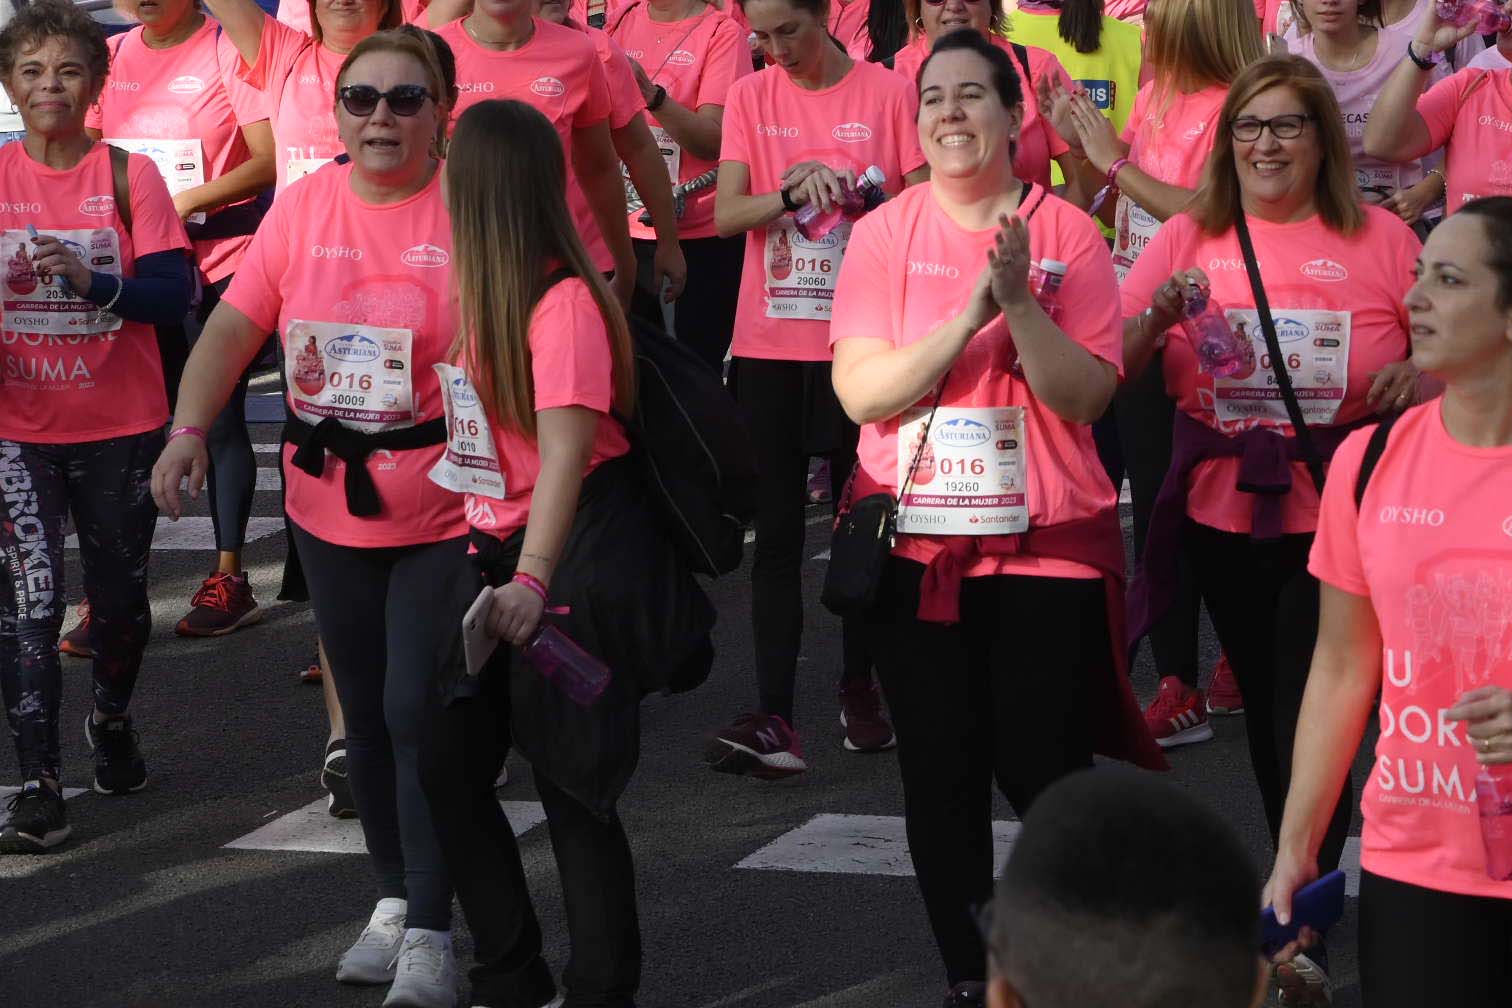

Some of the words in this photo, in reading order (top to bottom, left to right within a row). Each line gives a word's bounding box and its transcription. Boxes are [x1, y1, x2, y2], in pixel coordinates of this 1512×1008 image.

[757, 122, 799, 139] OYSHO
[311, 244, 364, 262] OYSHO
[795, 257, 832, 273] 016
[906, 260, 959, 280] OYSHO
[797, 276, 826, 287] 29060
[14, 316, 49, 326] OYSHO
[1260, 353, 1301, 369] 06
[6, 355, 91, 382] SUMA
[329, 371, 374, 390] 016
[330, 394, 365, 406] 30009
[335, 408, 343, 417] DE
[345, 410, 355, 419] LA
[356, 411, 380, 420] MUJER
[995, 423, 1016, 431] SUMA
[940, 429, 987, 440] ASTURIANA
[940, 458, 984, 475] 016
[945, 481, 979, 492] 19260
[912, 496, 946, 505] CARRERA
[946, 497, 958, 505] DE
[960, 497, 970, 506] LA
[971, 497, 999, 505] MUJER
[910, 514, 946, 524] OYSHO
[980, 514, 1020, 524] Santander
[1379, 506, 1445, 527] OYSHO
